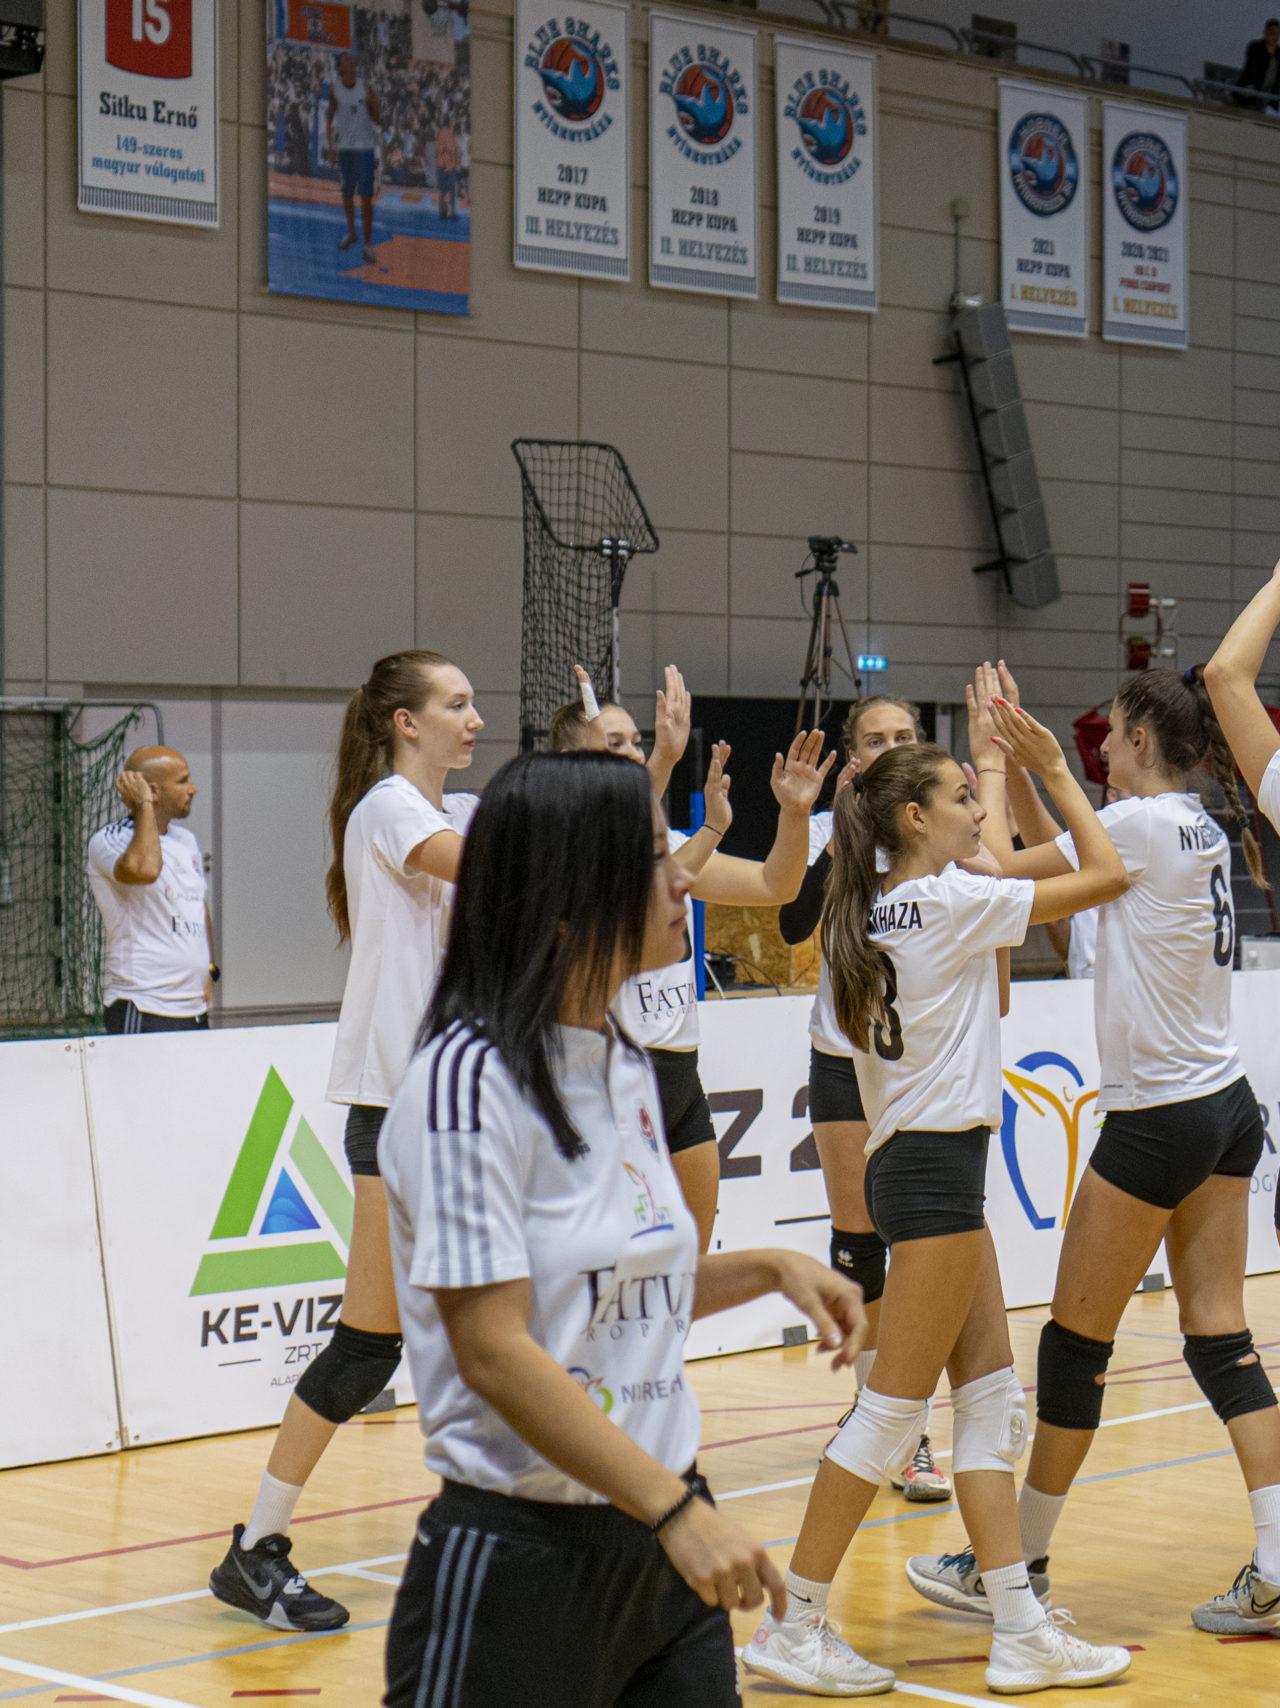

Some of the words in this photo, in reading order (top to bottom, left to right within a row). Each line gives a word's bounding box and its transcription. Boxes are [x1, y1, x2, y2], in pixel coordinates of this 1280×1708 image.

[132, 0, 171, 45] 15
[524, 18, 561, 72] BLUE
[565, 16, 620, 90] SHARKS
[659, 46, 693, 95] BLUE
[697, 44, 749, 115] SHARKS
[99, 91, 147, 121] Sitku
[153, 100, 198, 129] Ernő
[116, 134, 183, 160] 149-szeres
[92, 156, 141, 175] magyar
[145, 159, 205, 183] válogatott
[557, 163, 588, 185] 2017
[537, 186, 571, 207] HEPP
[574, 192, 607, 212] KUPA
[690, 185, 719, 206] 2018
[671, 208, 702, 226] HEPP
[706, 212, 738, 232] KUPA
[813, 205, 840, 224] 2019
[545, 218, 619, 246] HELYEZÉS
[797, 227, 826, 245] HEPP
[829, 232, 858, 249] KUPA
[678, 237, 748, 266] HELYEZÉS
[804, 255, 868, 280] HELYEZÉS
[1210, 864, 1233, 966] 6
[578, 1261, 696, 1326] FATU
